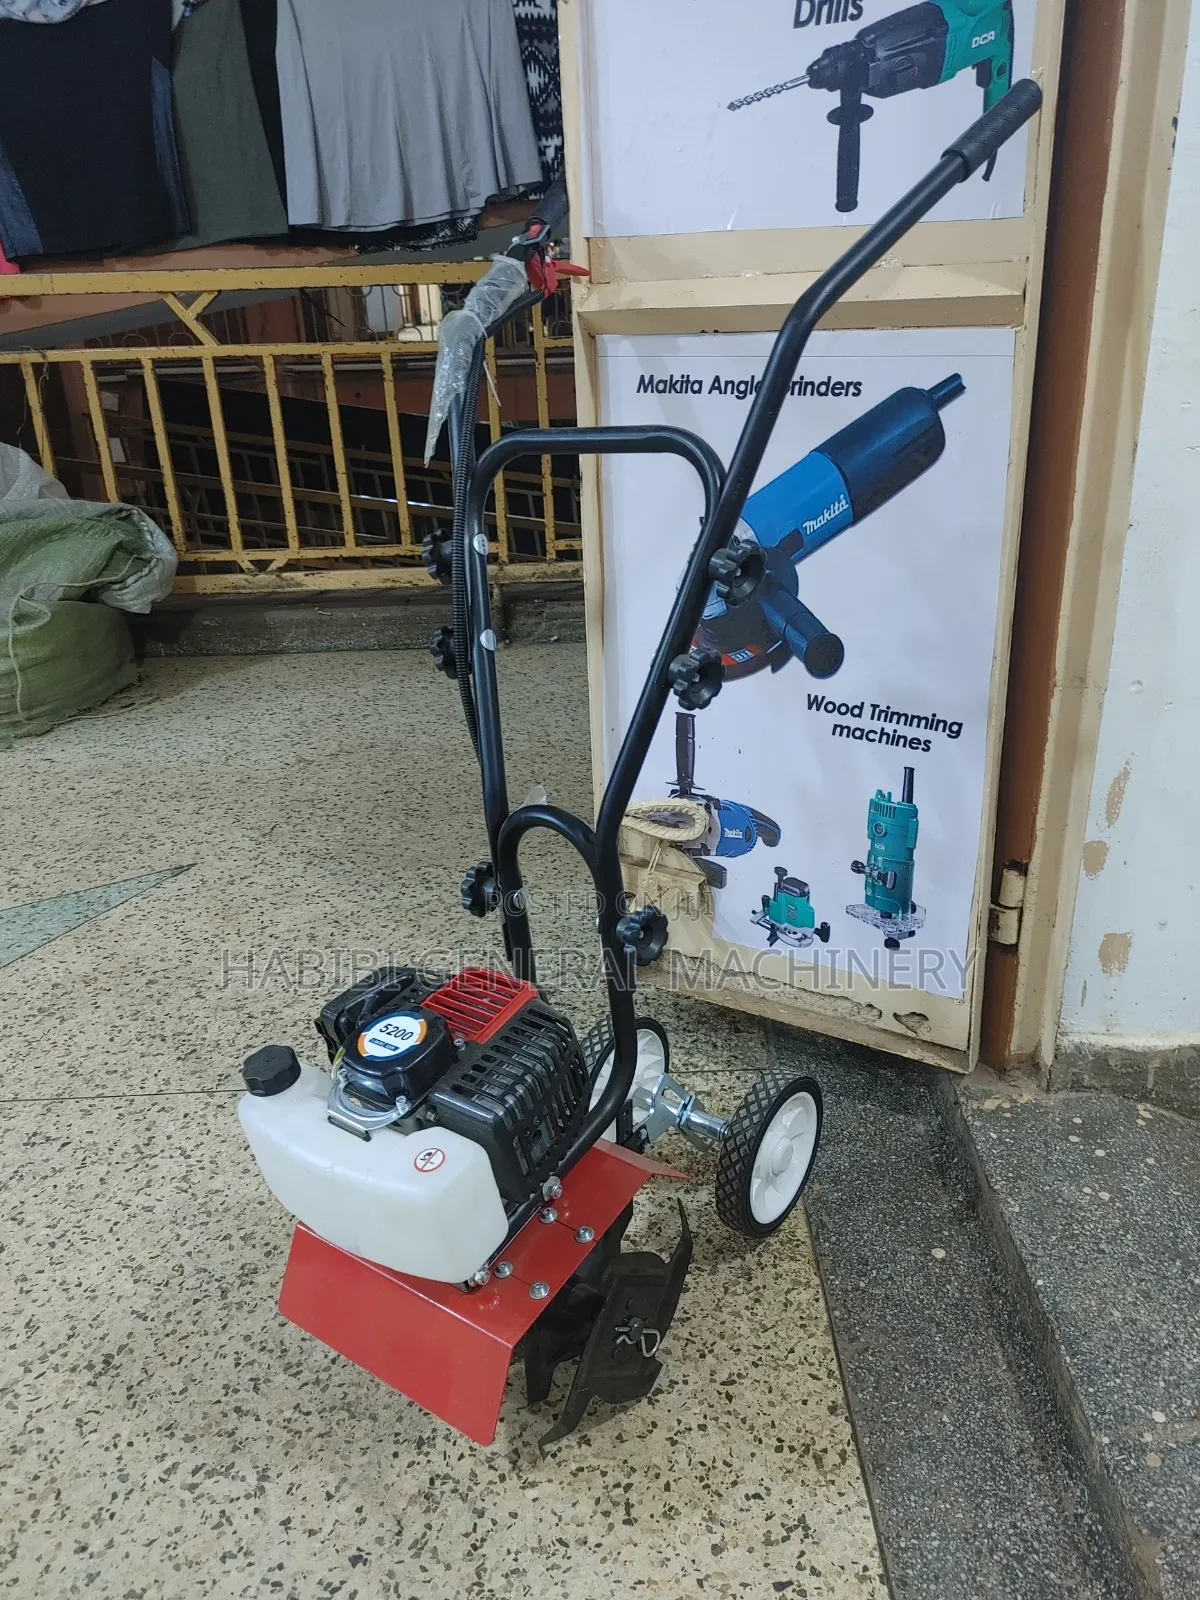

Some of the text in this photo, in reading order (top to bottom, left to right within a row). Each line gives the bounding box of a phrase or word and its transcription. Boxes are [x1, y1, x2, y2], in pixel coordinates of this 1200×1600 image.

[793, 0, 863, 29] Drills
[971, 30, 996, 49] DCA
[636, 374, 703, 394] Makita
[788, 375, 863, 398] rinders
[807, 693, 964, 739] Wood Trimming
[831, 723, 932, 752] machines
[379, 1023, 414, 1041] 5200
